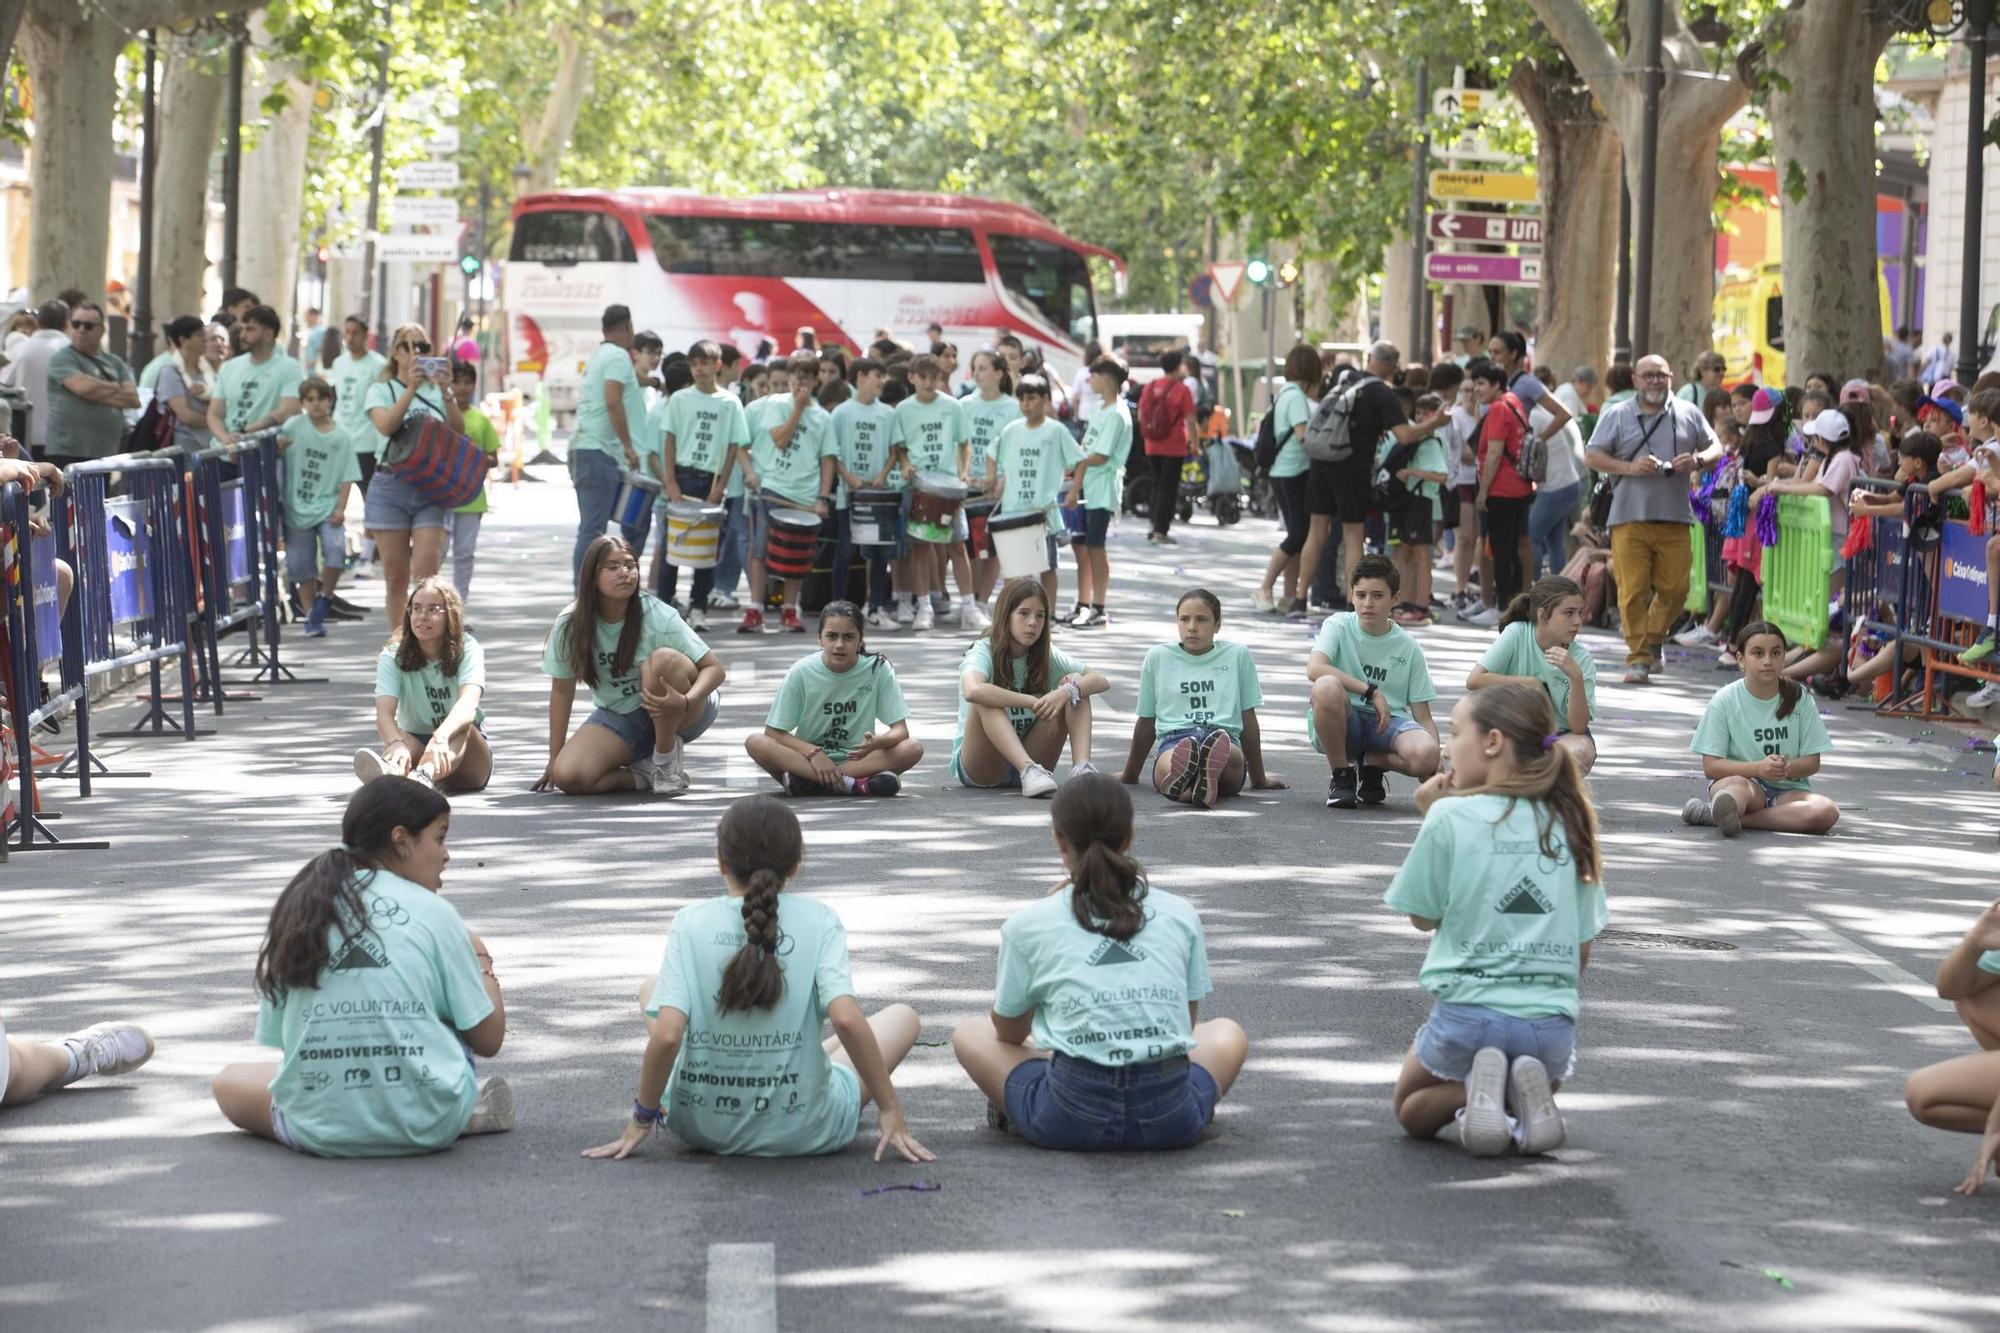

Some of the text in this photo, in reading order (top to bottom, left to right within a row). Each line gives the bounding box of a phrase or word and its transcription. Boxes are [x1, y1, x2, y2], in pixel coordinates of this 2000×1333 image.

[1437, 174, 1484, 185] mercat
[1511, 220, 1541, 241] UN
[696, 411, 718, 421] SOM
[700, 421, 711, 430] DI
[855, 422, 876, 431] SOM
[921, 422, 943, 433] SOM
[974, 417, 994, 427] SOM
[695, 432, 713, 441] VER
[860, 432, 870, 441] DI
[927, 433, 938, 442] DI
[697, 442, 706, 450] SI
[855, 442, 873, 451] VER
[923, 443, 943, 452] VER
[305, 448, 328, 461] SOM
[692, 452, 709, 461] TAT
[858, 452, 867, 461] SI
[929, 454, 940, 462] SI
[1020, 448, 1040, 457] SOM
[308, 460, 320, 471] DI
[853, 462, 870, 472] TAT
[1023, 459, 1033, 467] DI
[301, 469, 321, 482] VER
[1019, 469, 1037, 478] VER
[1022, 480, 1031, 489] SI
[1018, 491, 1035, 500] TAT
[1360, 662, 1387, 681] OM
[1180, 680, 1215, 694] SOM
[430, 701, 446, 714] DI
[823, 700, 857, 715] SOM
[1190, 696, 1208, 709] DI
[832, 715, 847, 727] DI
[1184, 711, 1215, 722] VER
[1753, 726, 1788, 741] SOM
[1763, 744, 1780, 757] DI
[1494, 875, 1557, 913] LEROY MERLIN
[1460, 941, 1485, 954] SC
[1091, 985, 1180, 1004] VOLUNTÀRIA
[1066, 1026, 1172, 1046] SOMDIVERSI
[299, 1045, 425, 1061] SOMDIVERSITAT
[680, 1070, 800, 1088] SOMDIVERSITAT
